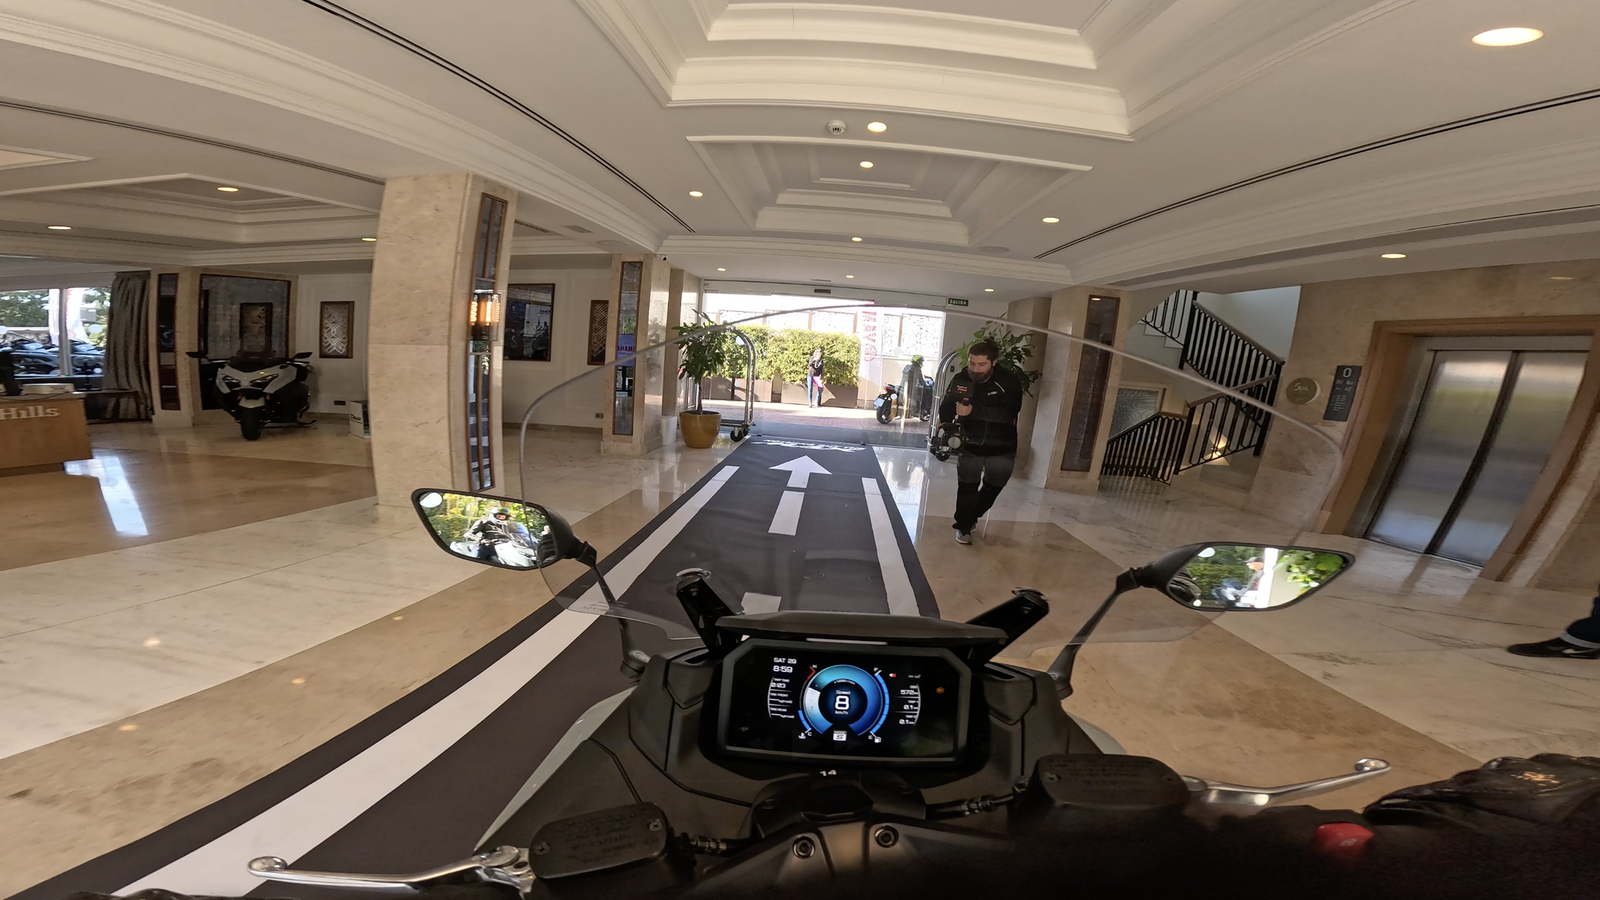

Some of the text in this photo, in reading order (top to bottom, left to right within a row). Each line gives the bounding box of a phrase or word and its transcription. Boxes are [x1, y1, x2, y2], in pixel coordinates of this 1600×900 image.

[0, 405, 60, 420] Hills
[773, 665, 793, 673] 8:59
[835, 695, 849, 710] 8
